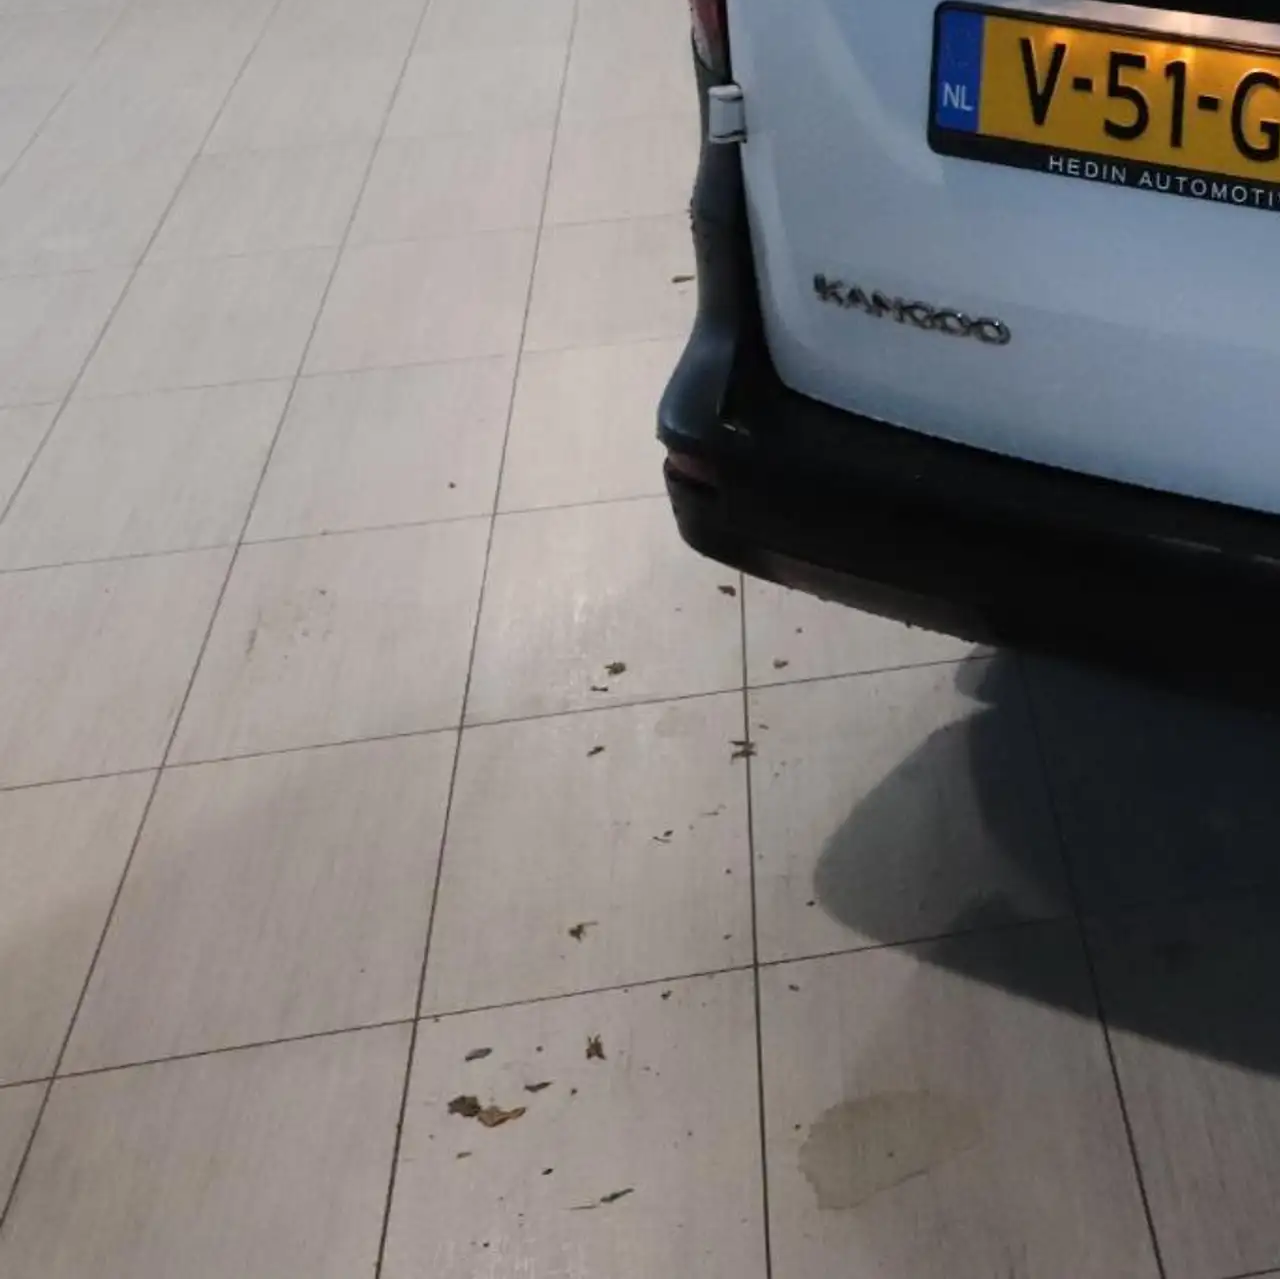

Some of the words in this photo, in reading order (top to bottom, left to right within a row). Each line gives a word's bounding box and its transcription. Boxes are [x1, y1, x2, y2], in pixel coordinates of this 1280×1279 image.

[942, 81, 974, 111] NL
[1049, 154, 1127, 184] HEDIN
[813, 272, 1012, 347] KANGOO
